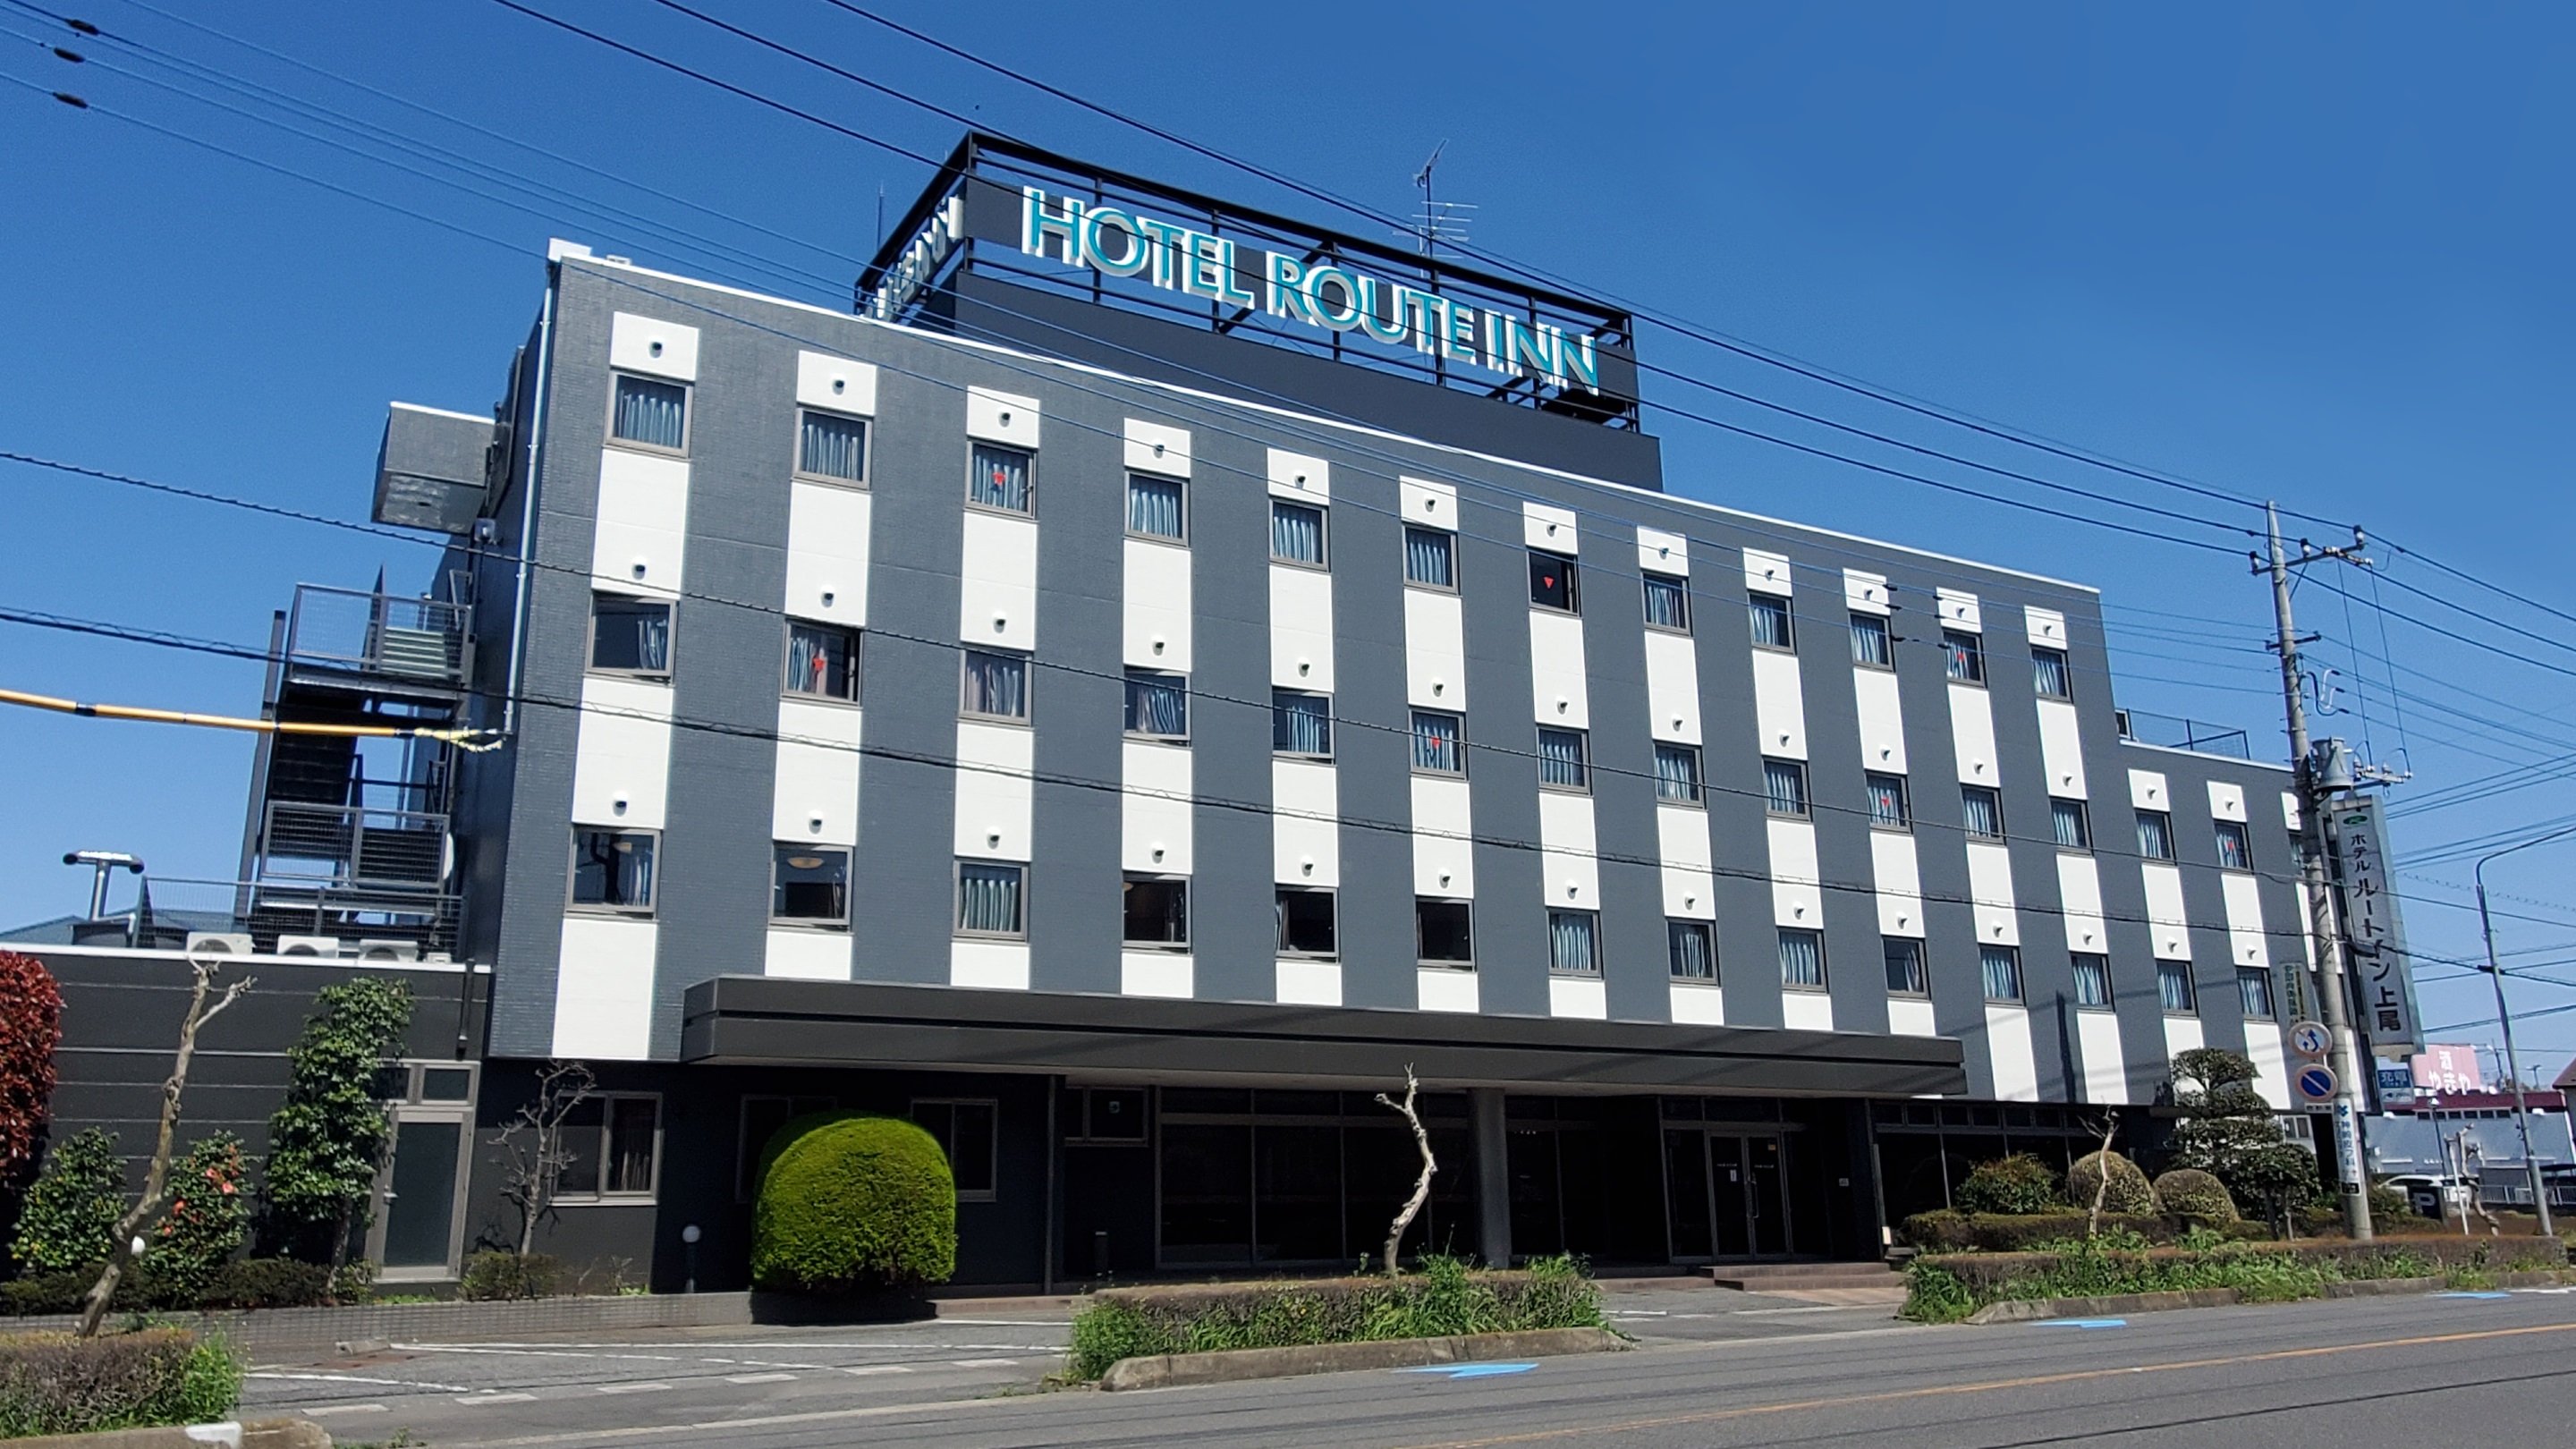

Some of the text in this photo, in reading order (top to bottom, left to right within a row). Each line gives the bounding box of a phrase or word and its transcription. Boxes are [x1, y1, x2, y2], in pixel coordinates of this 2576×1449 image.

[1021, 184, 1254, 310] HOTEL
[1265, 250, 1479, 366] ROUTE
[1485, 307, 1600, 396] INN
[2428, 1070, 2470, 1096] やまや
